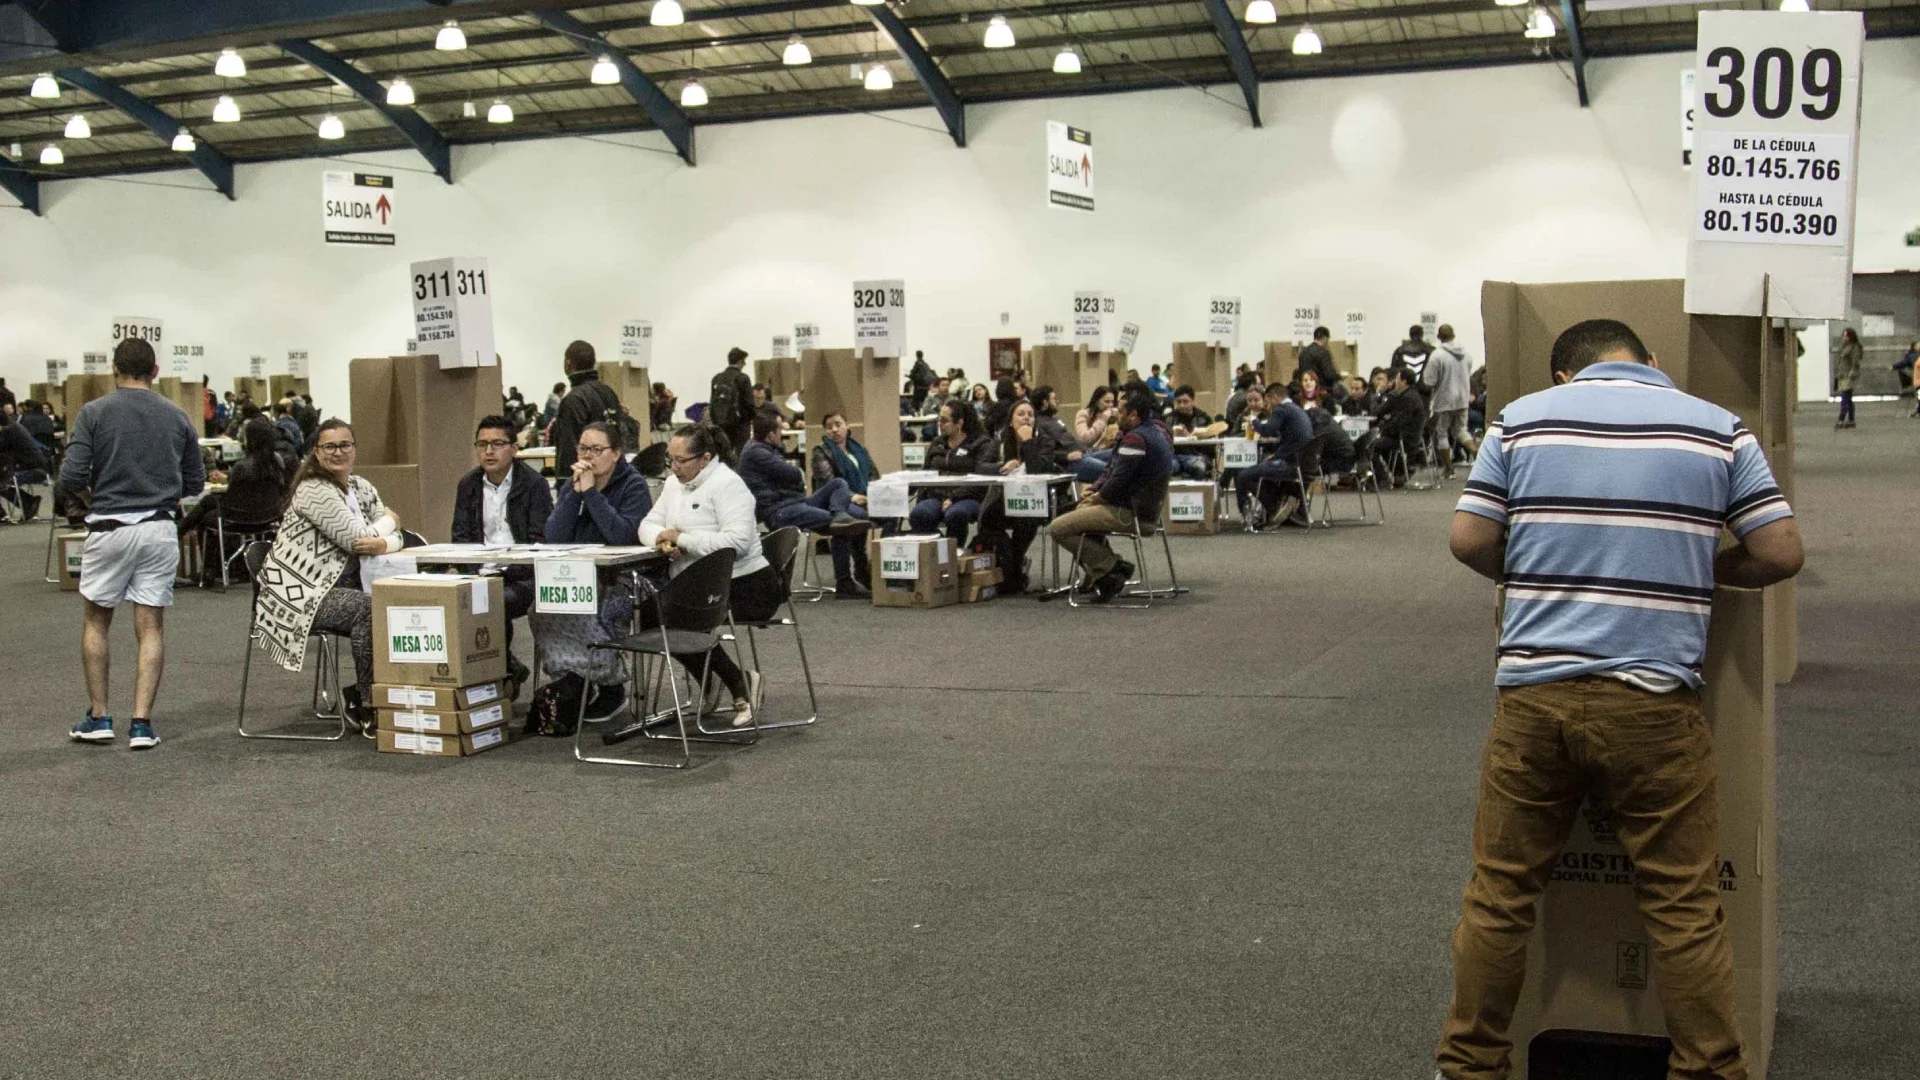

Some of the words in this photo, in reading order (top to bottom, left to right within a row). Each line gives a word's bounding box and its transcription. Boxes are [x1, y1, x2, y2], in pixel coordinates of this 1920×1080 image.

[1704, 46, 1842, 121] 309
[1734, 138, 1748, 150] DE
[1752, 139, 1766, 151] LA
[1770, 137, 1816, 153] CÉDULA
[1050, 153, 1080, 179] SALIDA
[1706, 154, 1841, 181] 80.145.766
[1719, 192, 1756, 205] HASTA
[1759, 194, 1773, 206] LA
[1777, 192, 1824, 208] CÉDULA
[326, 199, 373, 220] SALIDA
[1703, 209, 1838, 237] 80.150.390
[414, 270, 450, 301] 311
[457, 269, 486, 296] 311
[853, 288, 886, 309] 320
[889, 287, 905, 308] 320
[1074, 297, 1100, 313] 323
[1211, 300, 1234, 315] 332
[1294, 307, 1313, 320] 335
[112, 323, 138, 341] 319
[140, 326, 161, 342] 319
[622, 325, 641, 338] 331
[172, 345, 189, 357] 330
[1226, 454, 1243, 463] MESA
[1007, 498, 1029, 510] MESA
[1031, 498, 1044, 510] 311
[1171, 506, 1189, 516] MESA
[883, 560, 902, 572] MESA
[903, 560, 915, 572] 311
[540, 585, 569, 604] MESA
[571, 585, 593, 603] 308
[392, 635, 422, 653] MESA
[423, 634, 443, 652] 308
